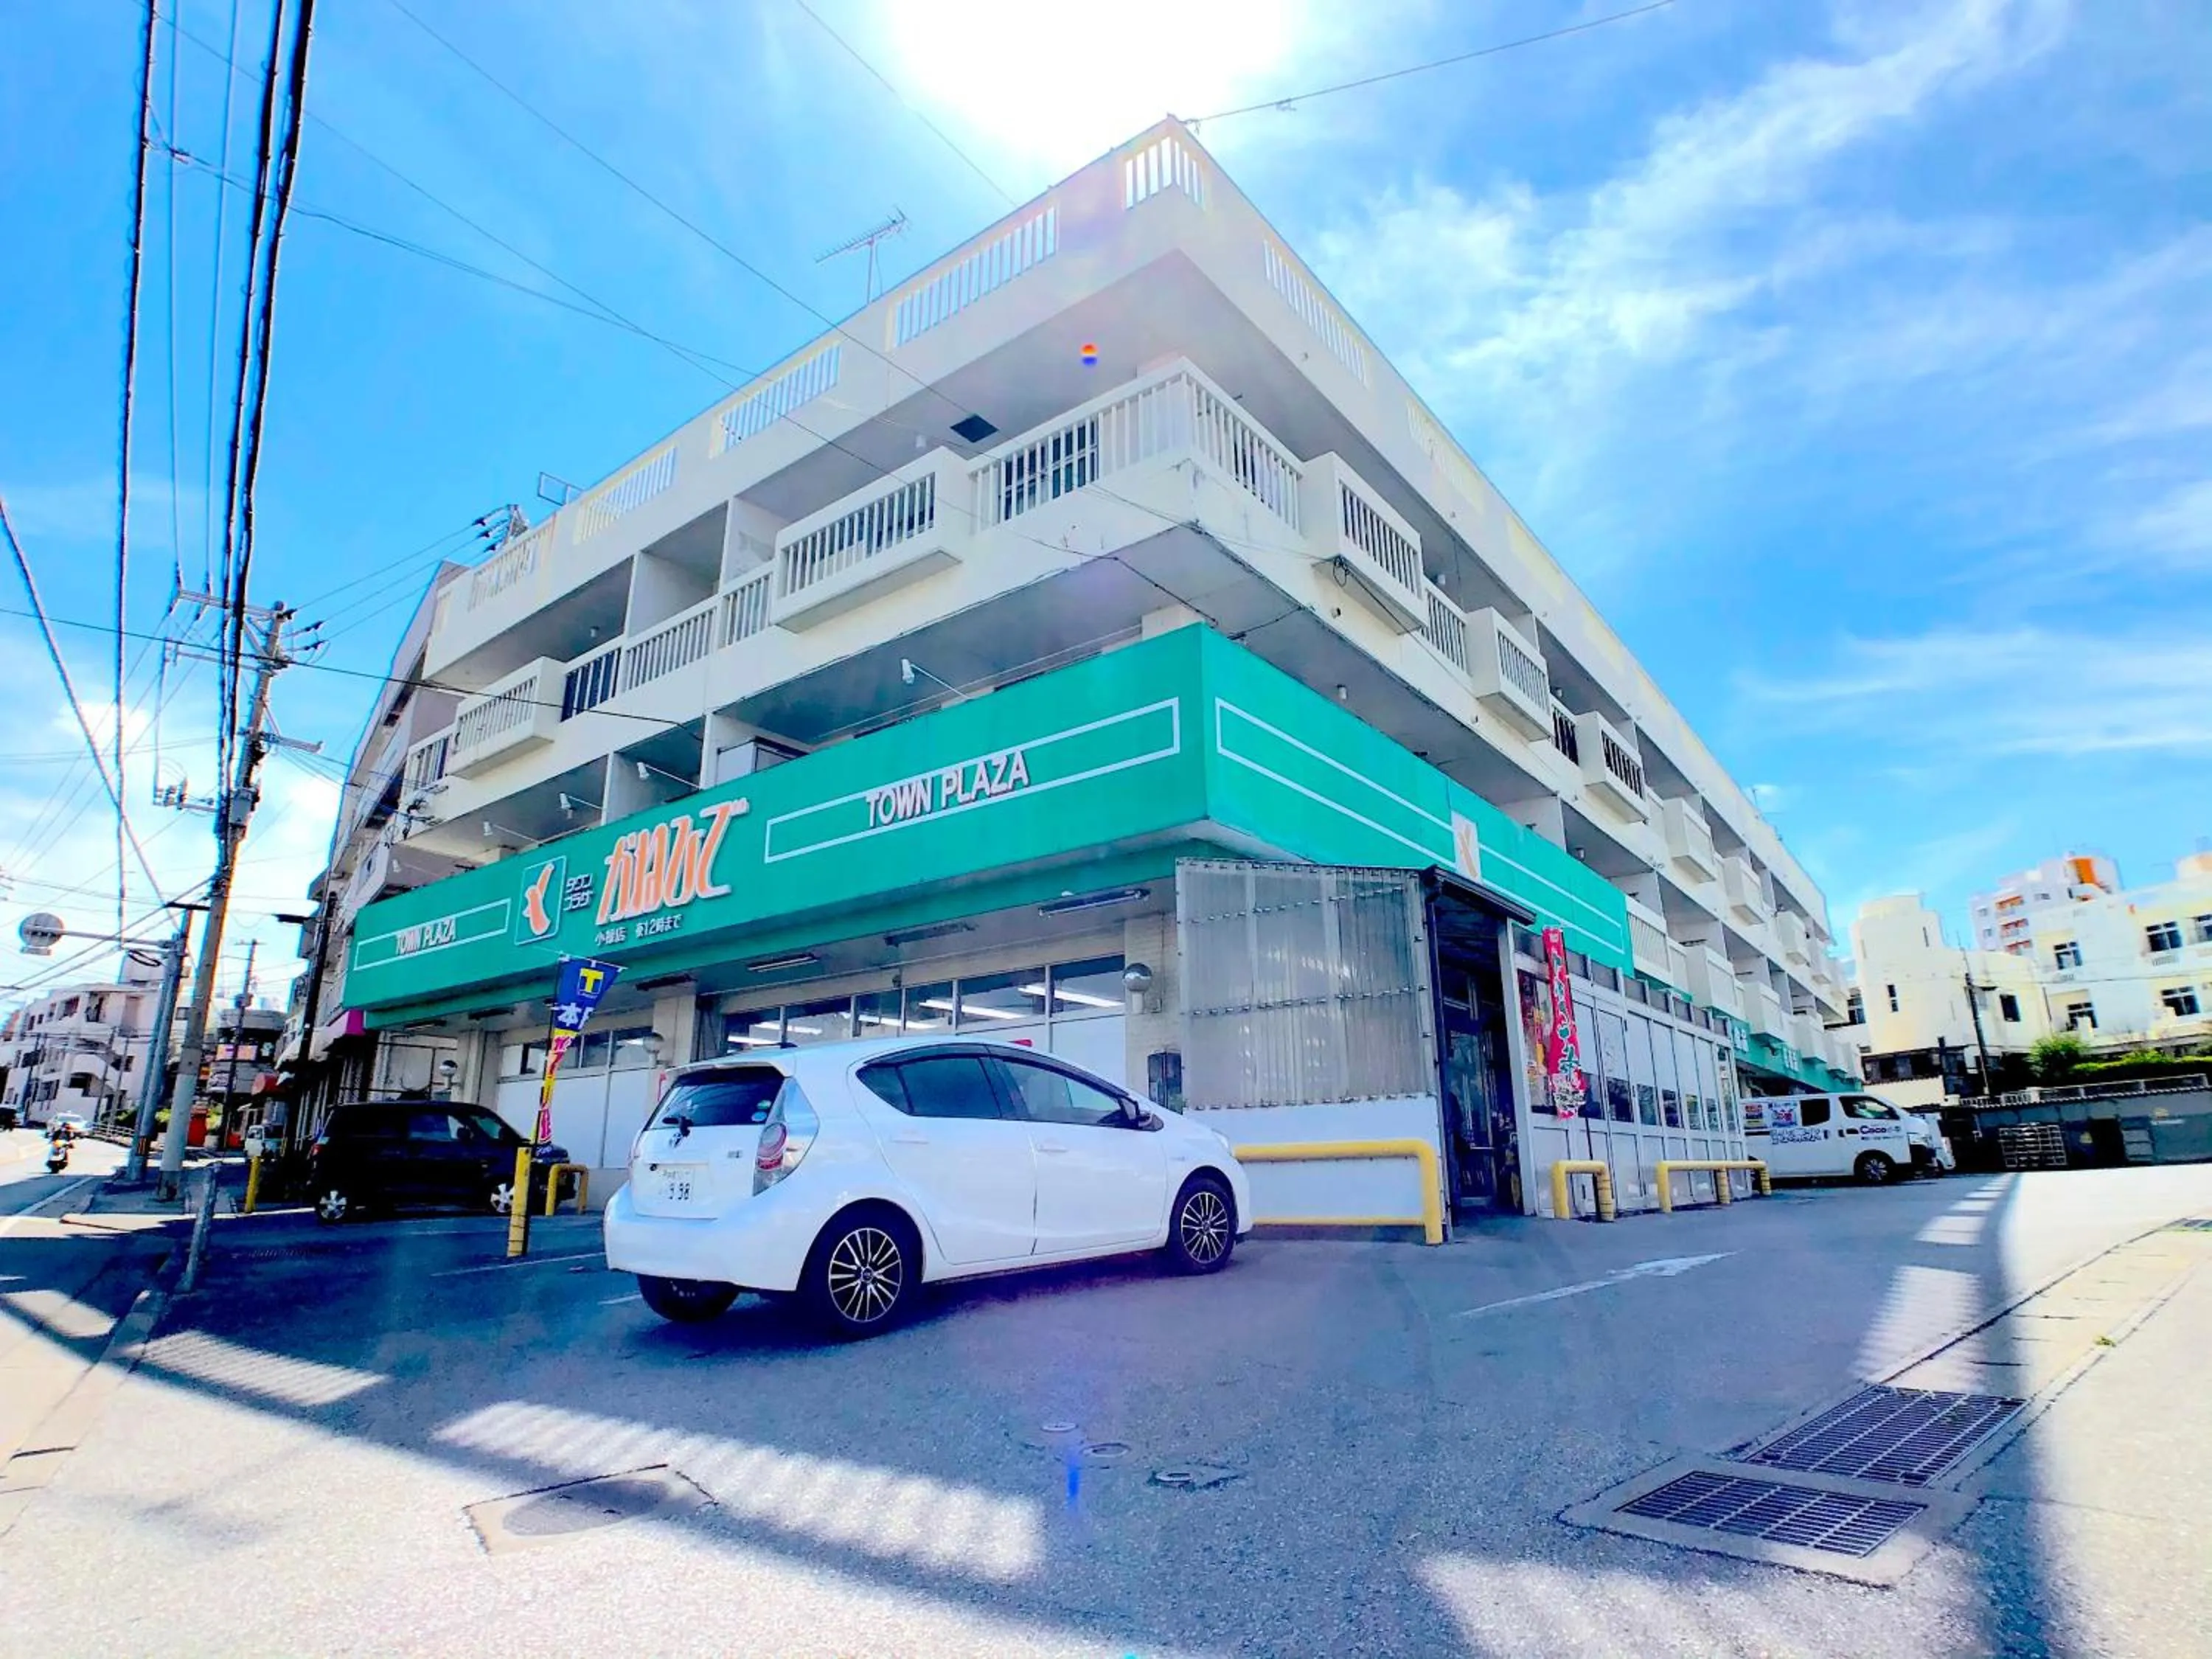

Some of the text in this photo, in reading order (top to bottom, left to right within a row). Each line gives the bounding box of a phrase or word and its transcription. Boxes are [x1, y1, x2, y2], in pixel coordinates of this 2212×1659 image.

[866, 749, 1030, 828] TOWN PLAZA
[395, 917, 456, 956] TOWN PLAZA
[580, 967, 604, 993] T
